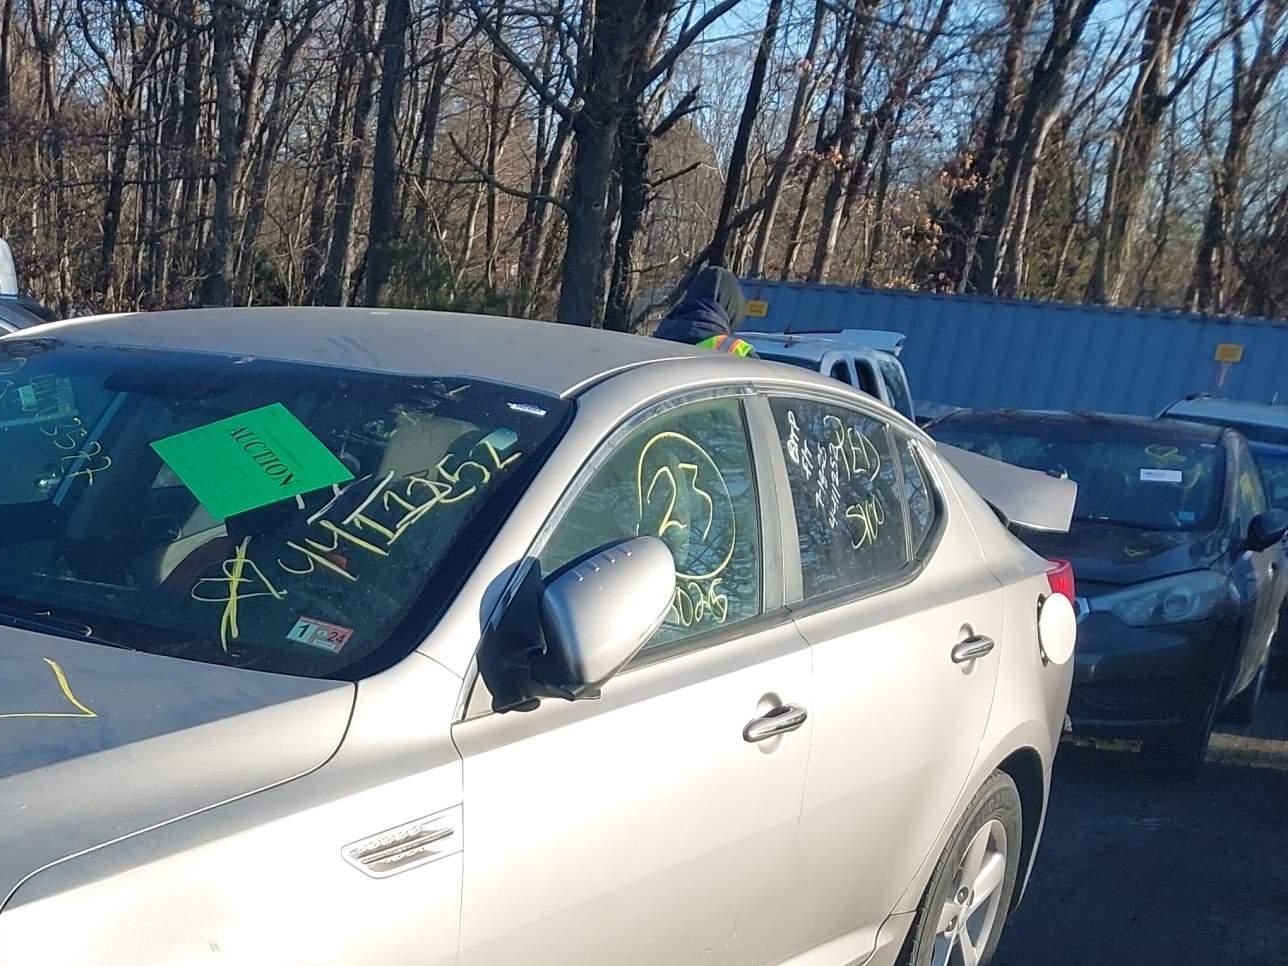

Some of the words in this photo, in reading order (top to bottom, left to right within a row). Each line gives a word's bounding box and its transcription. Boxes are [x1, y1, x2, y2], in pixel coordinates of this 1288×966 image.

[226, 425, 300, 487] AUCTION
[647, 462, 713, 542] 23
[299, 624, 311, 638] 1
[327, 631, 347, 645] 24
